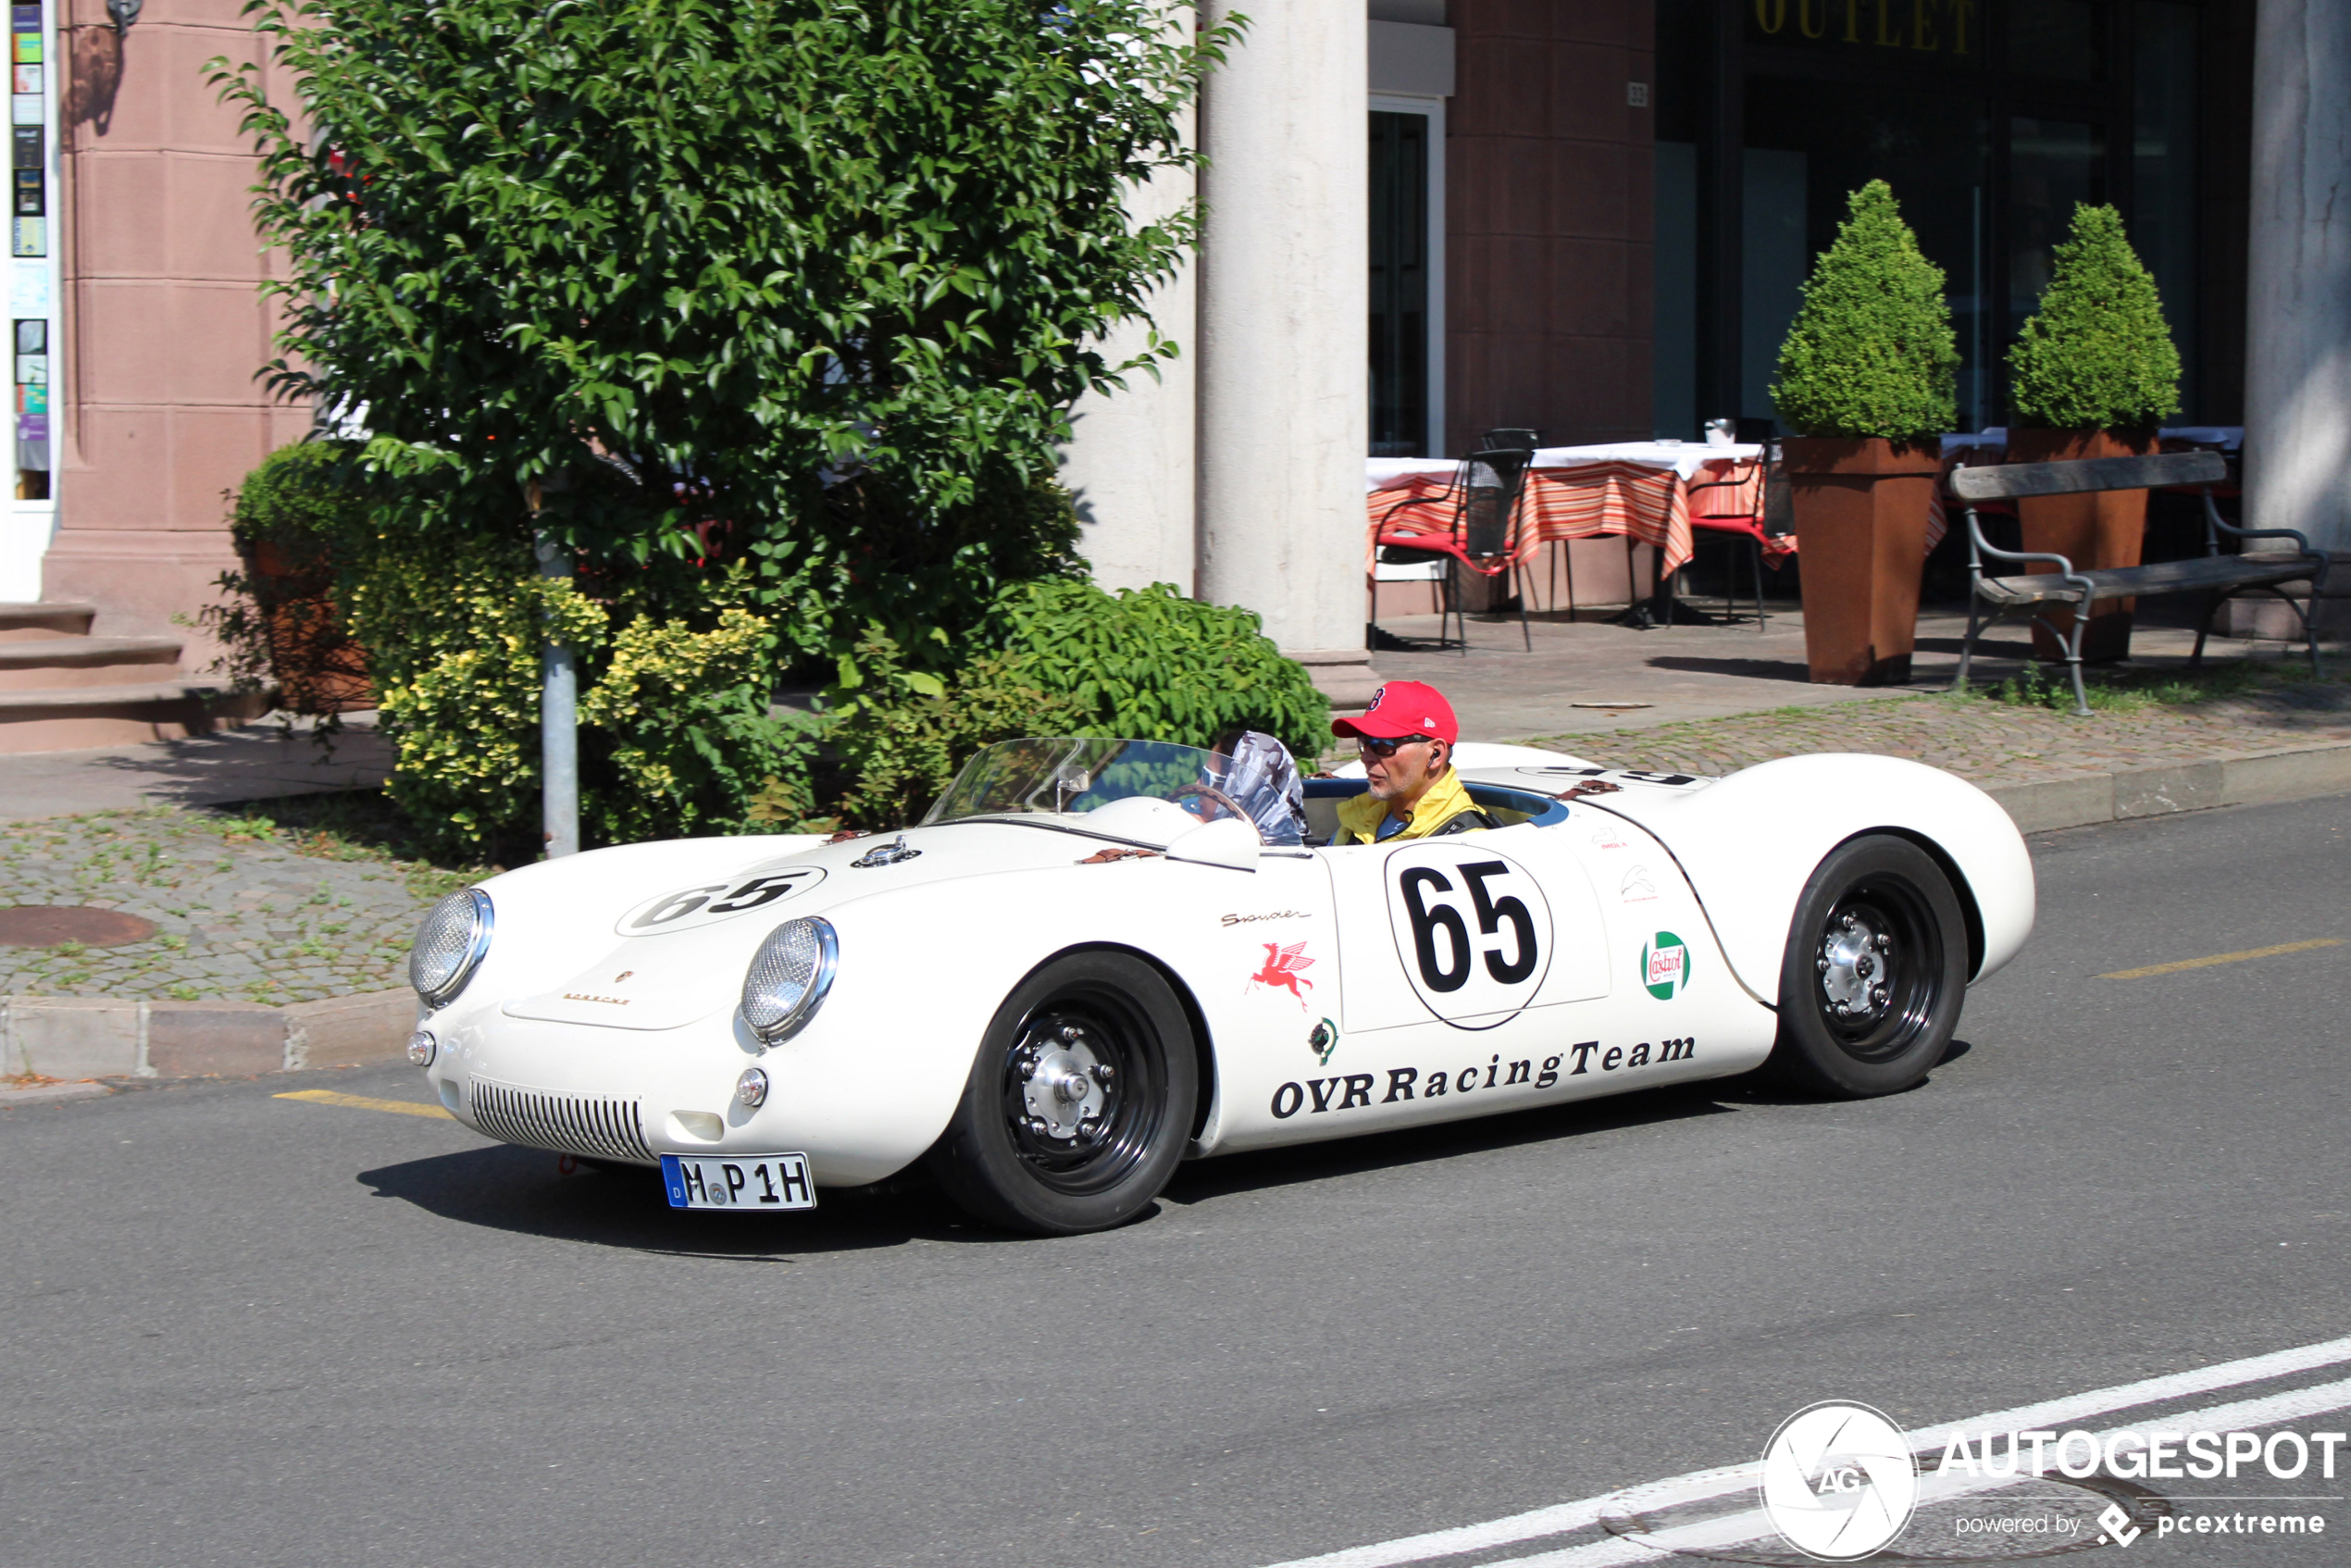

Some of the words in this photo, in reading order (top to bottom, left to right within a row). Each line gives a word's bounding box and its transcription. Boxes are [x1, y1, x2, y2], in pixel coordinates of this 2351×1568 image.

[1755, 0, 1974, 54] OUTLET
[1366, 688, 1386, 712] B
[630, 871, 813, 928] 65
[1399, 860, 1537, 993] 65
[1648, 948, 1682, 982] Castrol
